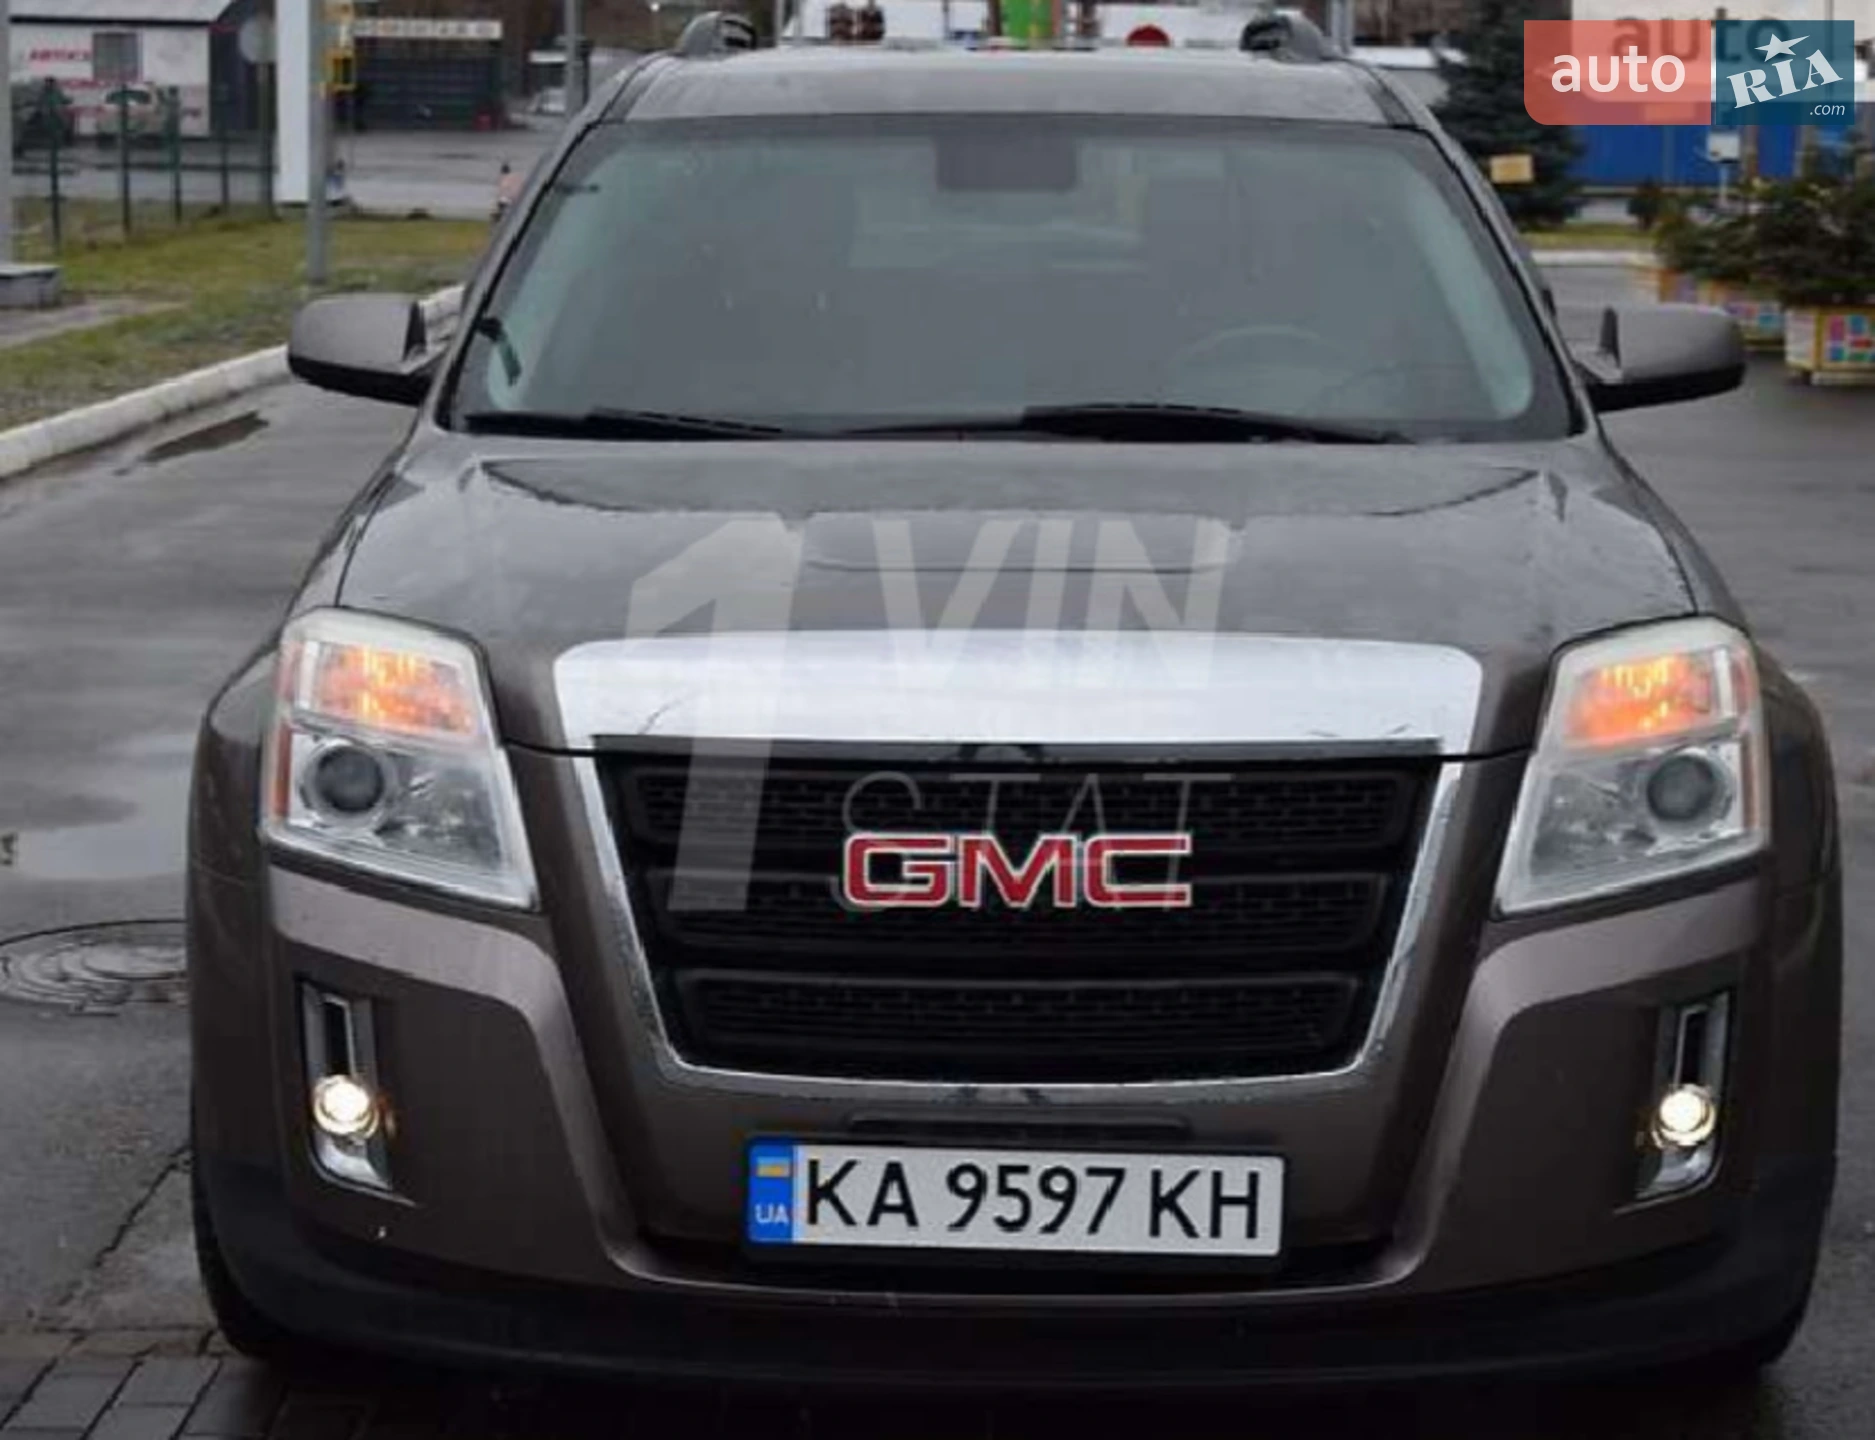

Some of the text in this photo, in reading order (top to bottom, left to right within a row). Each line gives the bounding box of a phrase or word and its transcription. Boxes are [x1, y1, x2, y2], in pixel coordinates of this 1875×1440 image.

[844, 832, 1192, 909] GMC
[754, 1202, 790, 1225] UA
[806, 1158, 1260, 1239] KA 9597 KH
